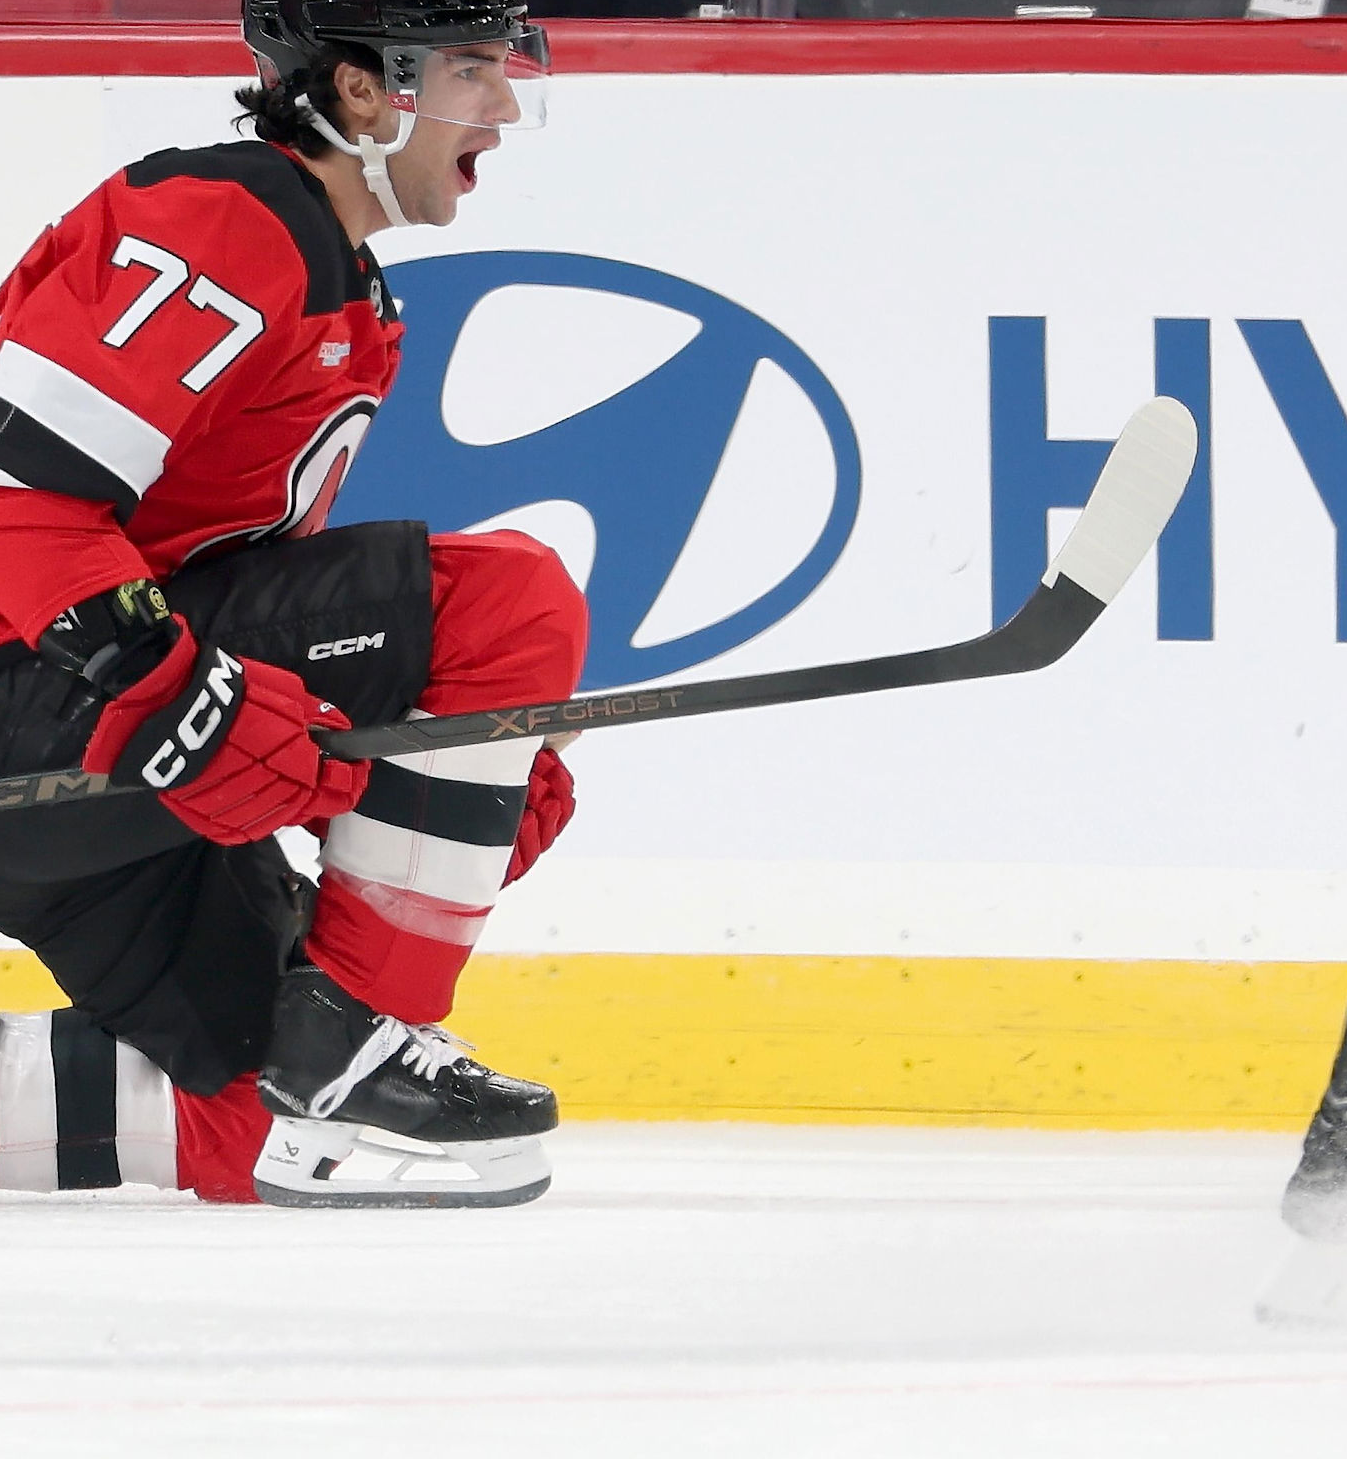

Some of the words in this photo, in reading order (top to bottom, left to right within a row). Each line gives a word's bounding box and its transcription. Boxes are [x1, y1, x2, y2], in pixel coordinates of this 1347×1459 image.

[101, 235, 266, 394] 77
[307, 631, 385, 662] CCM
[141, 647, 244, 790] CCM
[486, 703, 556, 738] XF
[562, 690, 685, 722] GHOST
